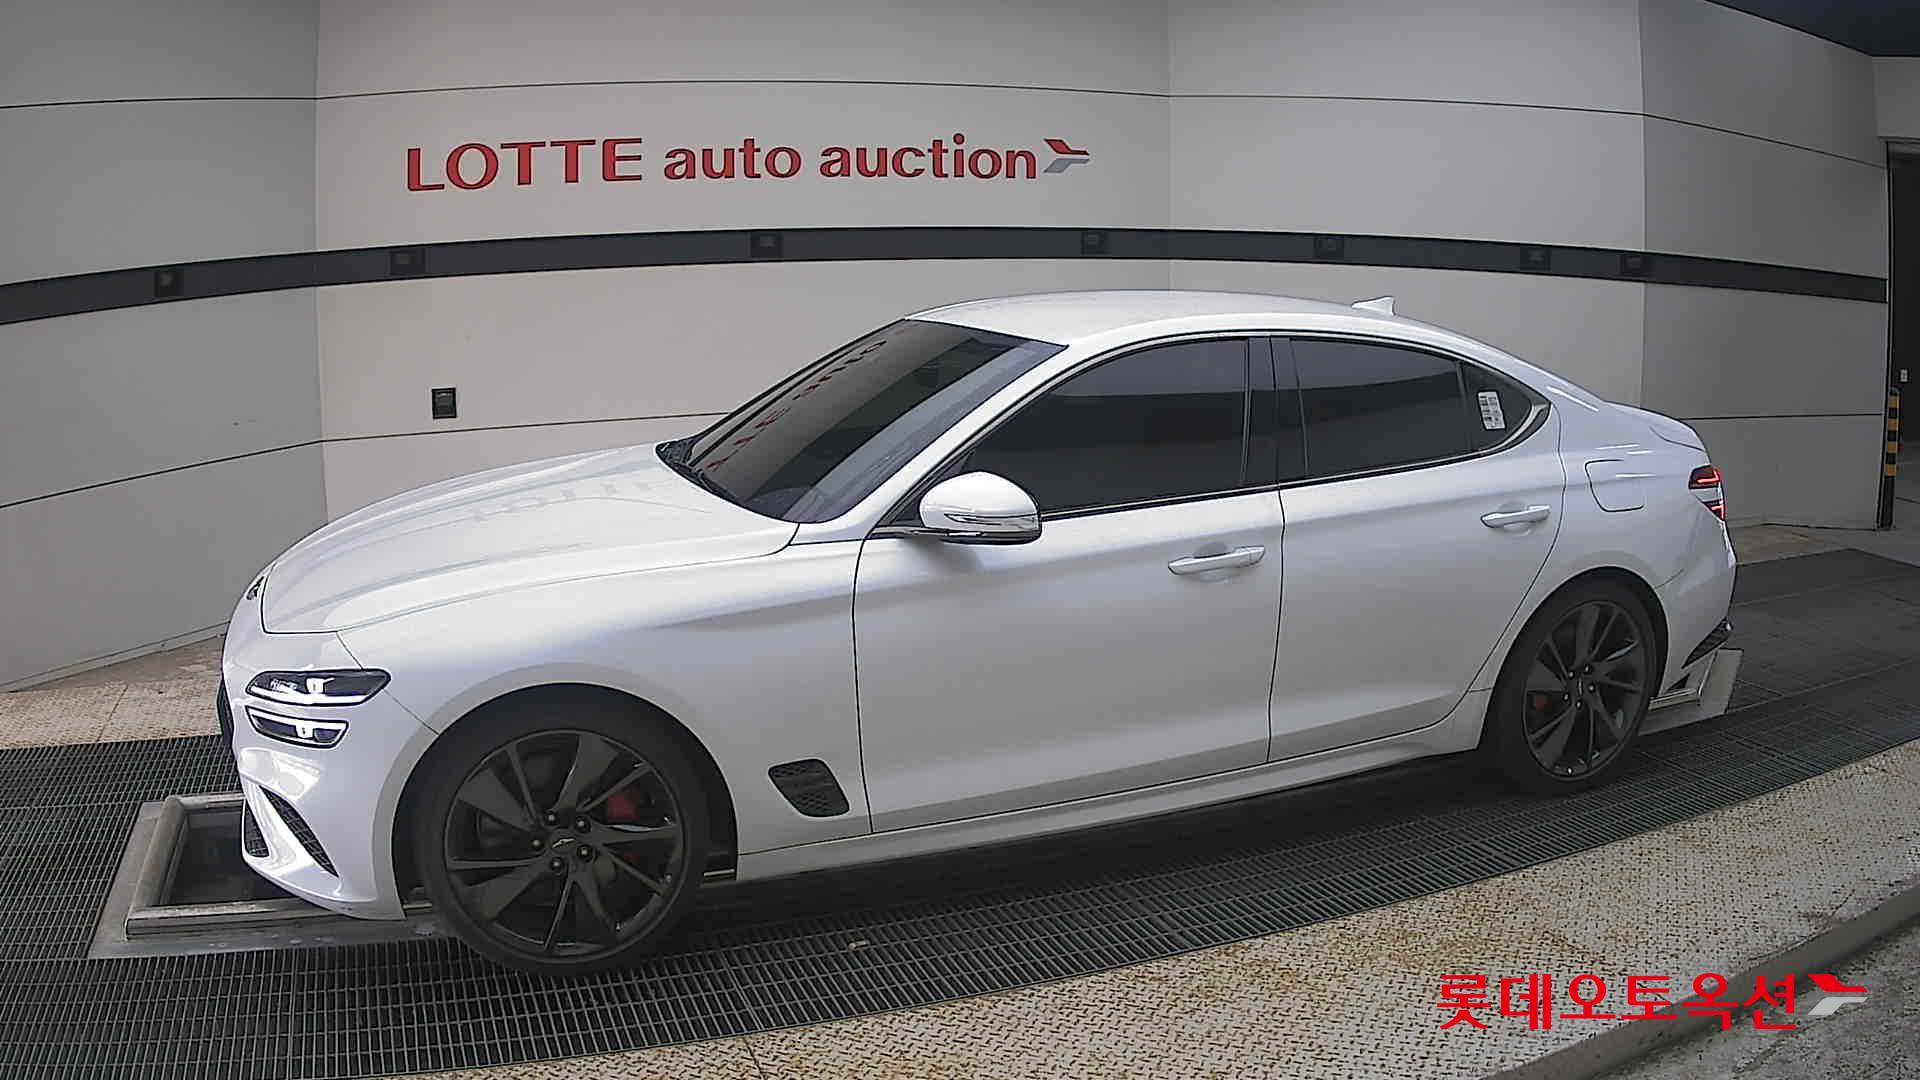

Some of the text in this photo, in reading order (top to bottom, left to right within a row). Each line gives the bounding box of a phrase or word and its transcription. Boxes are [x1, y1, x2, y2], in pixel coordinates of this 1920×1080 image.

[407, 133, 1038, 191] LOTTE auto auction
